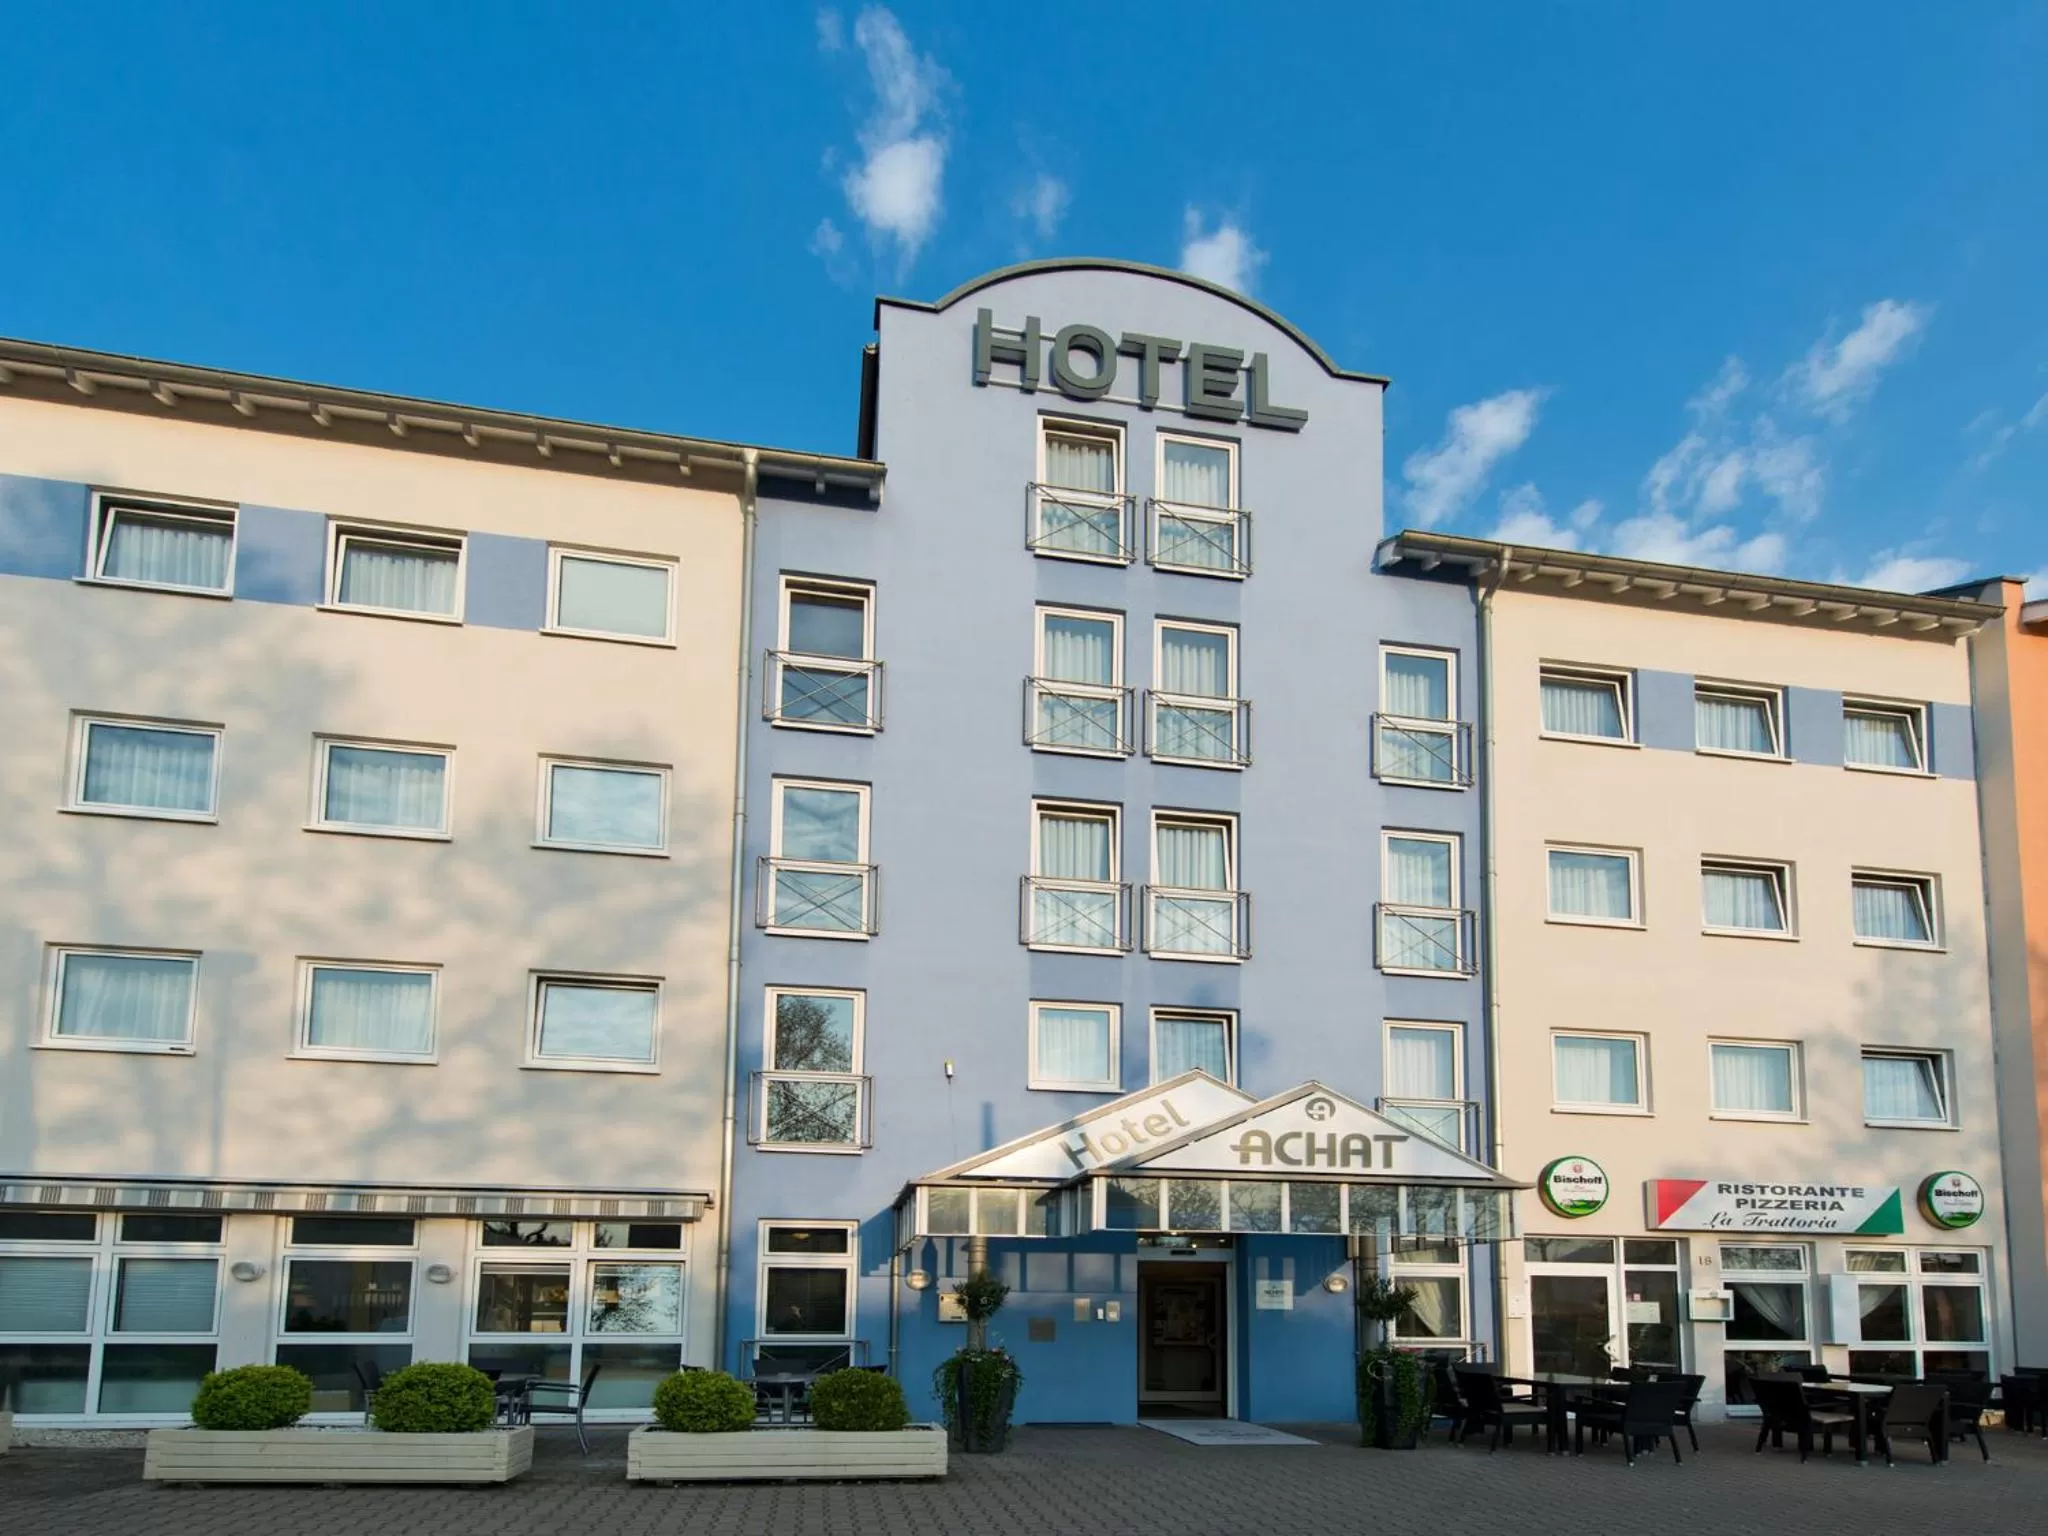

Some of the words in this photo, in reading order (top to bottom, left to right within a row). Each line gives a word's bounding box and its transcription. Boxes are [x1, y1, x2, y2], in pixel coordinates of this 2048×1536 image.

[974, 307, 1308, 432] HOTEL
[1058, 1099, 1191, 1170] Hotel
[1230, 1129, 1410, 1169] ACHAT
[1553, 1175, 1602, 1184] Bischoff
[1717, 1183, 1865, 1198] RISTORANTE
[1934, 1189, 1978, 1197] Bischoff
[1735, 1198, 1844, 1212] PIZZERIA
[1701, 1211, 1732, 1229] La
[1742, 1211, 1838, 1229] Trattoria
